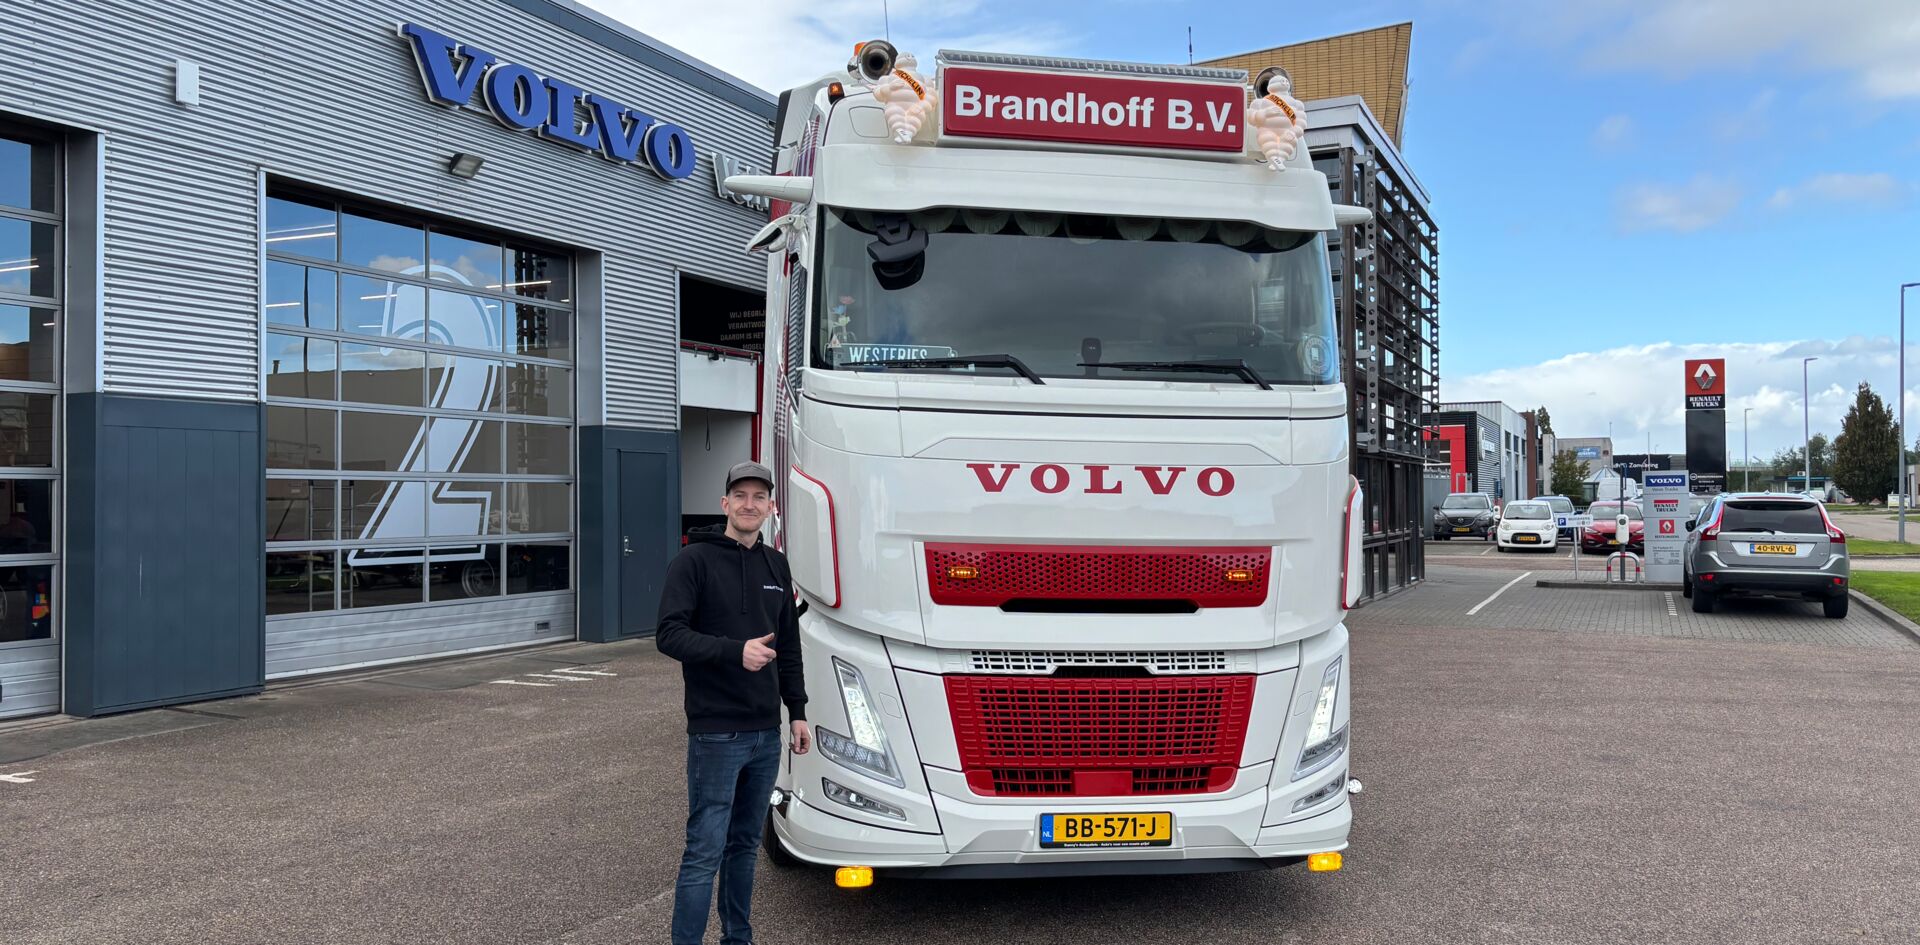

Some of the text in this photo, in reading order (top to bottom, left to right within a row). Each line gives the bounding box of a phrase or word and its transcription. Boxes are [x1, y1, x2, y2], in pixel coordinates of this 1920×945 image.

[400, 23, 697, 181] VOLVO
[955, 84, 1236, 133] Brandhoff B.V.
[347, 264, 500, 567] 2
[966, 463, 1235, 497] VOLVO
[1065, 816, 1156, 838] BB-571-J
